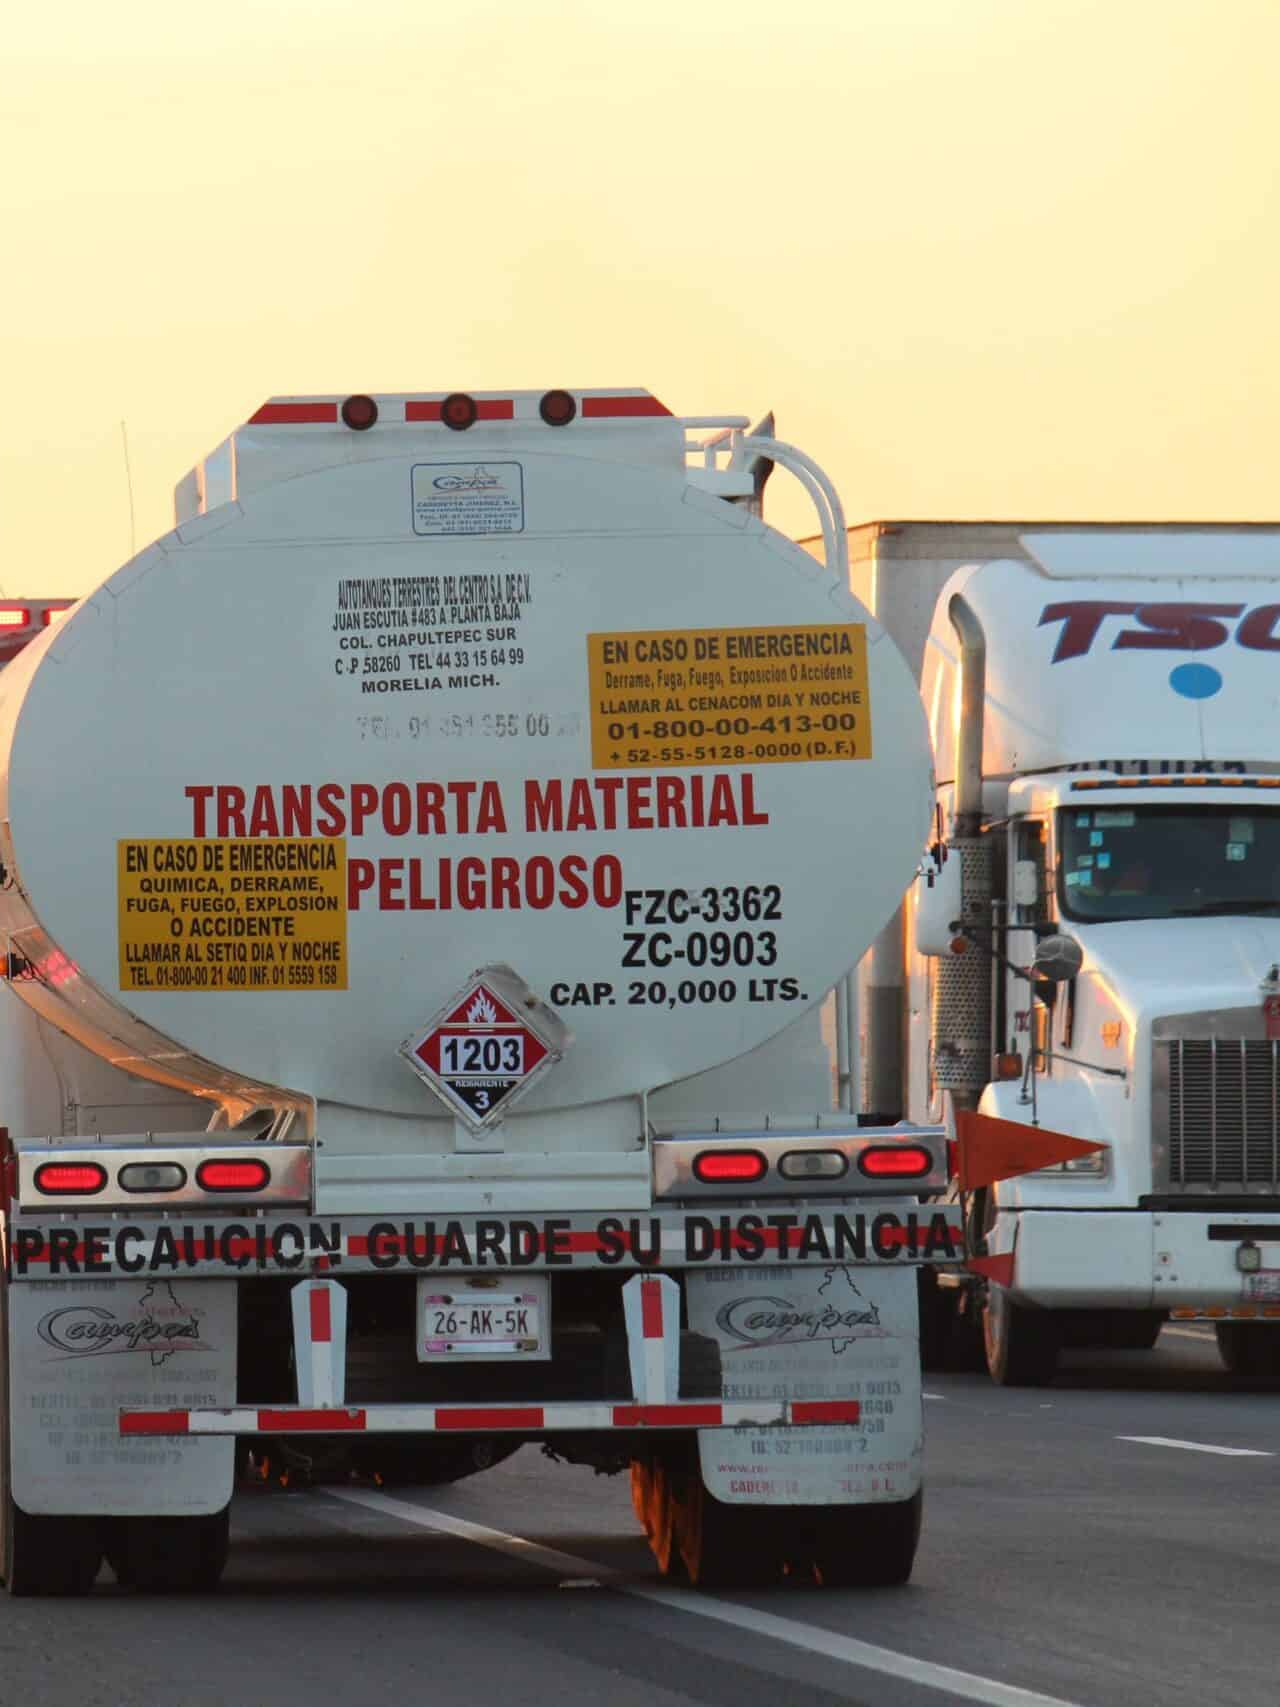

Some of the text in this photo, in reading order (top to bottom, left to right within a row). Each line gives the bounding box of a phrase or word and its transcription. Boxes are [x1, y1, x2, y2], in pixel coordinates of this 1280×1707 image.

[338, 578, 391, 609] AUTOTANQUES
[393, 576, 440, 608] TERRESTRES
[444, 576, 458, 605] DEL
[458, 575, 488, 605] CENTRO
[333, 604, 521, 631] JUAN ESCUTIA #483 A PLANTA BAJA
[339, 627, 516, 650] COL. CHAPULTEPEC SUR
[602, 632, 853, 664] EN CASO DE EMERGENCIA
[436, 653, 451, 669] 44
[455, 651, 469, 667] 33
[474, 650, 487, 667] 15
[491, 649, 505, 666] 64
[509, 648, 524, 665] 99
[361, 674, 500, 693] MORELIA MICH.
[605, 671, 655, 690] Derrame,
[657, 668, 687, 691] Fuga,
[689, 667, 724, 690] Fuego,
[790, 664, 798, 682] O
[801, 663, 853, 682] Accidente
[600, 691, 861, 714] LLAMAR AL CENACOM DIA Y NOCHE
[608, 713, 856, 740] 01-800-00-413-00
[627, 742, 802, 763] 52-55-5128-0000
[185, 773, 769, 838] TRANSPORTA MATERIAL
[126, 844, 337, 872] EN CASO DE EMERGENCIA
[140, 877, 324, 895] QUIMICA, DERRAME,
[347, 855, 623, 910] PELIGROSO
[127, 896, 339, 915] FUGA, FUEGO, EXPLOSION
[624, 885, 782, 926] FZC-3362
[171, 917, 295, 937] O ACCIDENTE
[126, 942, 340, 962] LLAMAR AL SETIQ DIA Y NOCHE
[621, 931, 777, 967] ZC-0903
[130, 967, 154, 986] TEL.
[157, 967, 208, 986] 01-800-00
[211, 966, 223, 985] 21
[227, 966, 246, 985] 400
[250, 966, 270, 985] INF.
[272, 966, 285, 985] 01
[550, 978, 809, 1009] CAP. 20,000 LTS.
[445, 1038, 520, 1072] 1203
[474, 1090, 490, 1110] 3
[17, 1213, 957, 1274] PRECAUCION GUARDE SU DISTANCIA
[434, 1309, 528, 1335] 26-AK-5K
